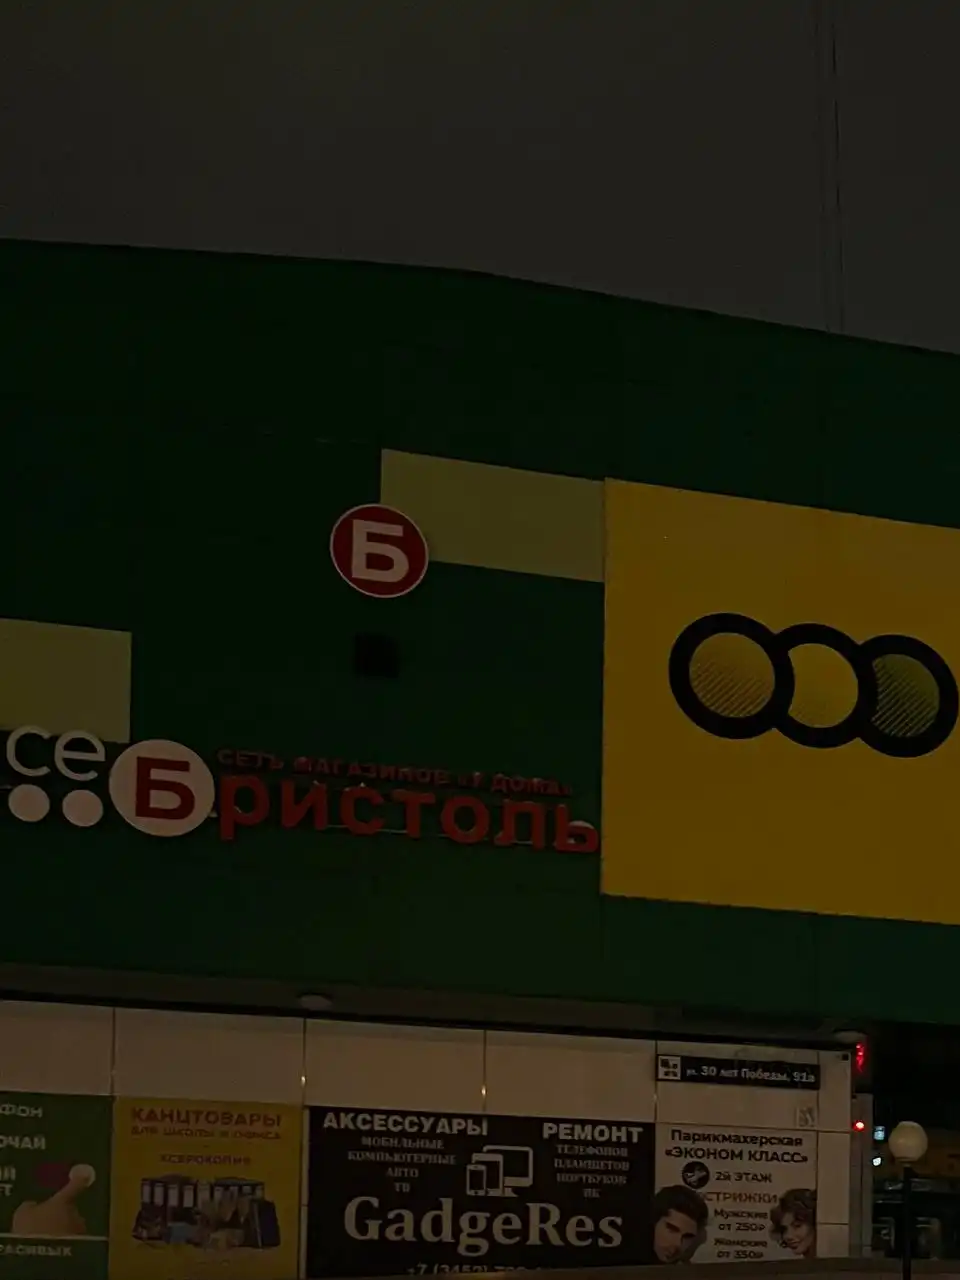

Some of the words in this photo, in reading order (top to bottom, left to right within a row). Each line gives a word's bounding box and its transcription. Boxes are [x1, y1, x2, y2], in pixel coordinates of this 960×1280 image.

[351, 518, 409, 584] Б
[700, 1065, 717, 1077] 30
[132, 1107, 281, 1127] КАНЦТОВАРЫ
[323, 1112, 488, 1136] АКСЕССУАРЫ
[542, 1122, 643, 1144] РЕМОНТ
[671, 1129, 803, 1147] Парикмахерская
[361, 1136, 444, 1149] МОБИЛЬНЫЕ
[386, 1166, 419, 1178] АВТО
[735, 1171, 772, 1183] ЭТАЖ
[705, 1191, 778, 1204] СТРИЖКИ
[714, 1209, 768, 1220] Мужские
[344, 1196, 623, 1257] GadgeRes
